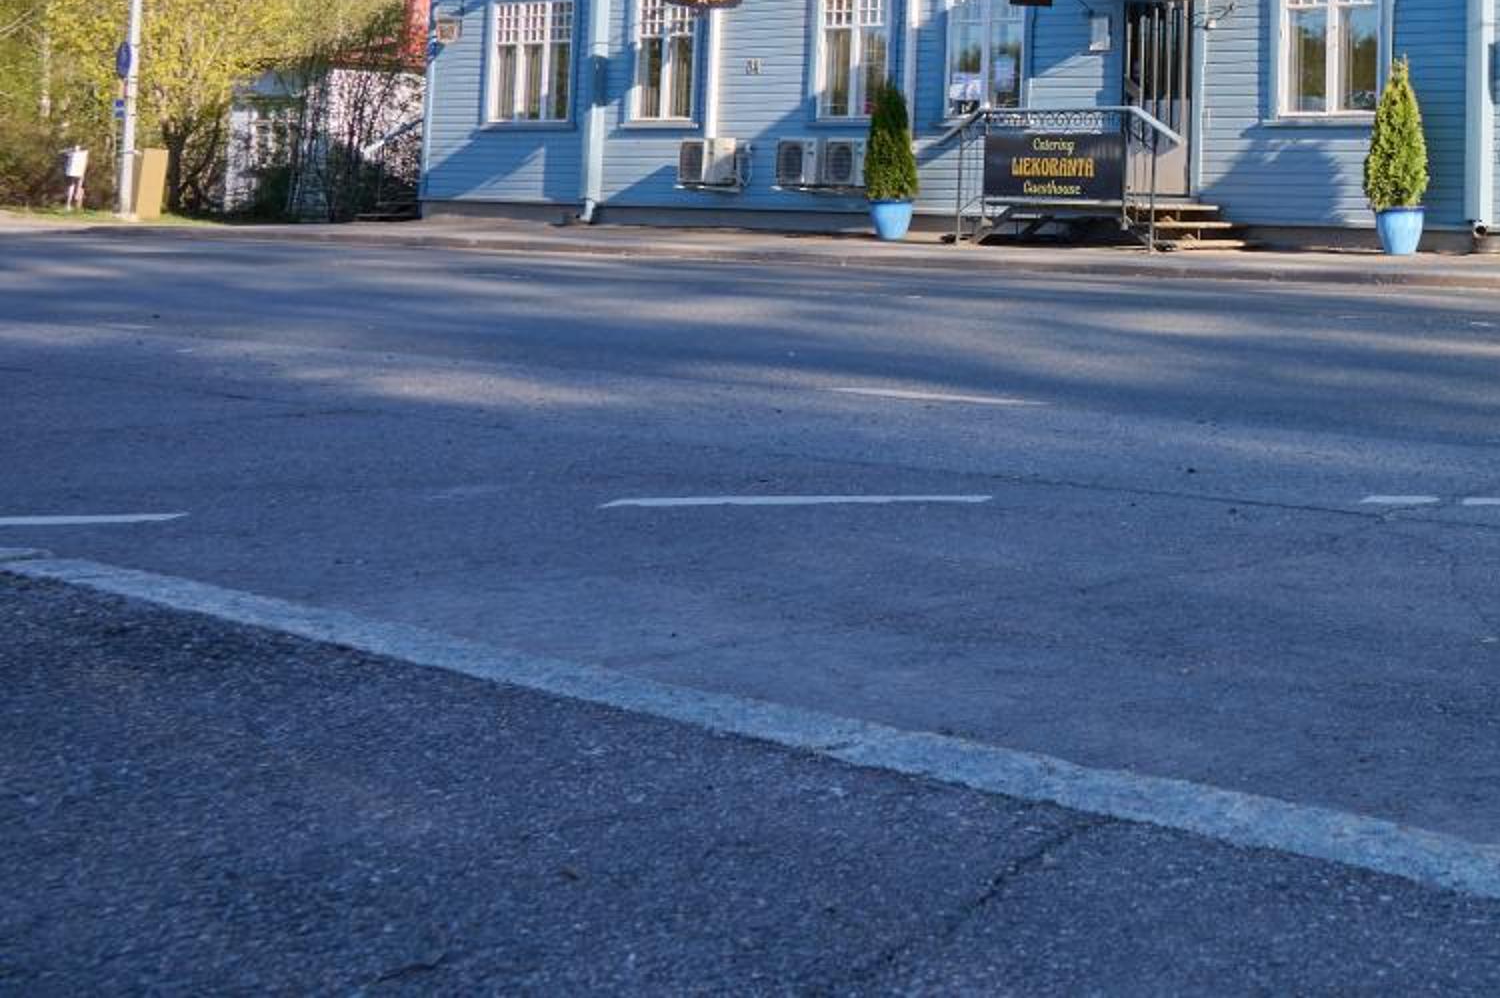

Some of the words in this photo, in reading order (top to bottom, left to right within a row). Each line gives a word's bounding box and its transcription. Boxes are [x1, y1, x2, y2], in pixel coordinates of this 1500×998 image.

[1033, 137, 1075, 155] Catering
[1011, 157, 1095, 177] LIEKORANTA
[1023, 179, 1081, 194] Guesthouse
